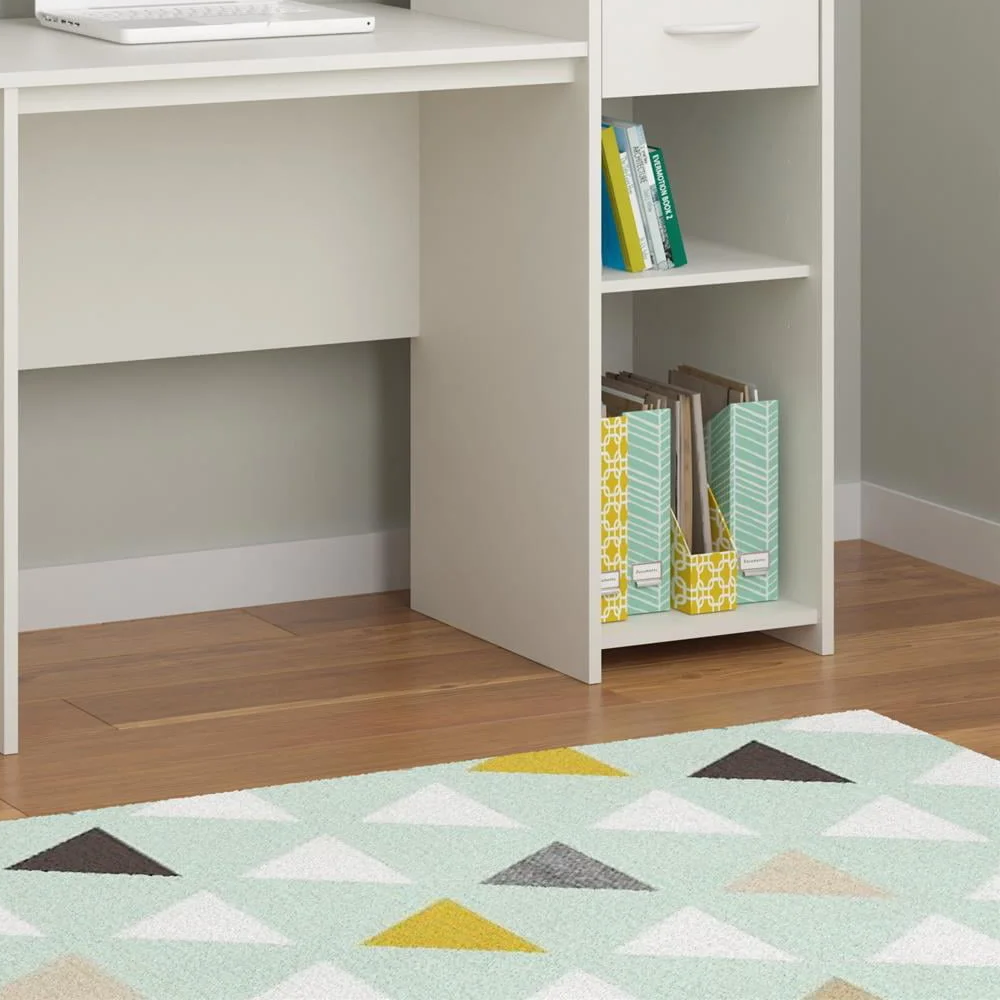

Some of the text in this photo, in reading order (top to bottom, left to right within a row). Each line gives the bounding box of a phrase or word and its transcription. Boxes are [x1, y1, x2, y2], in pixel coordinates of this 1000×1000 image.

[633, 146, 648, 184] ARCHITECTURE
[652, 154, 668, 196] EVERMOTION
[661, 196, 673, 215] BOOK
